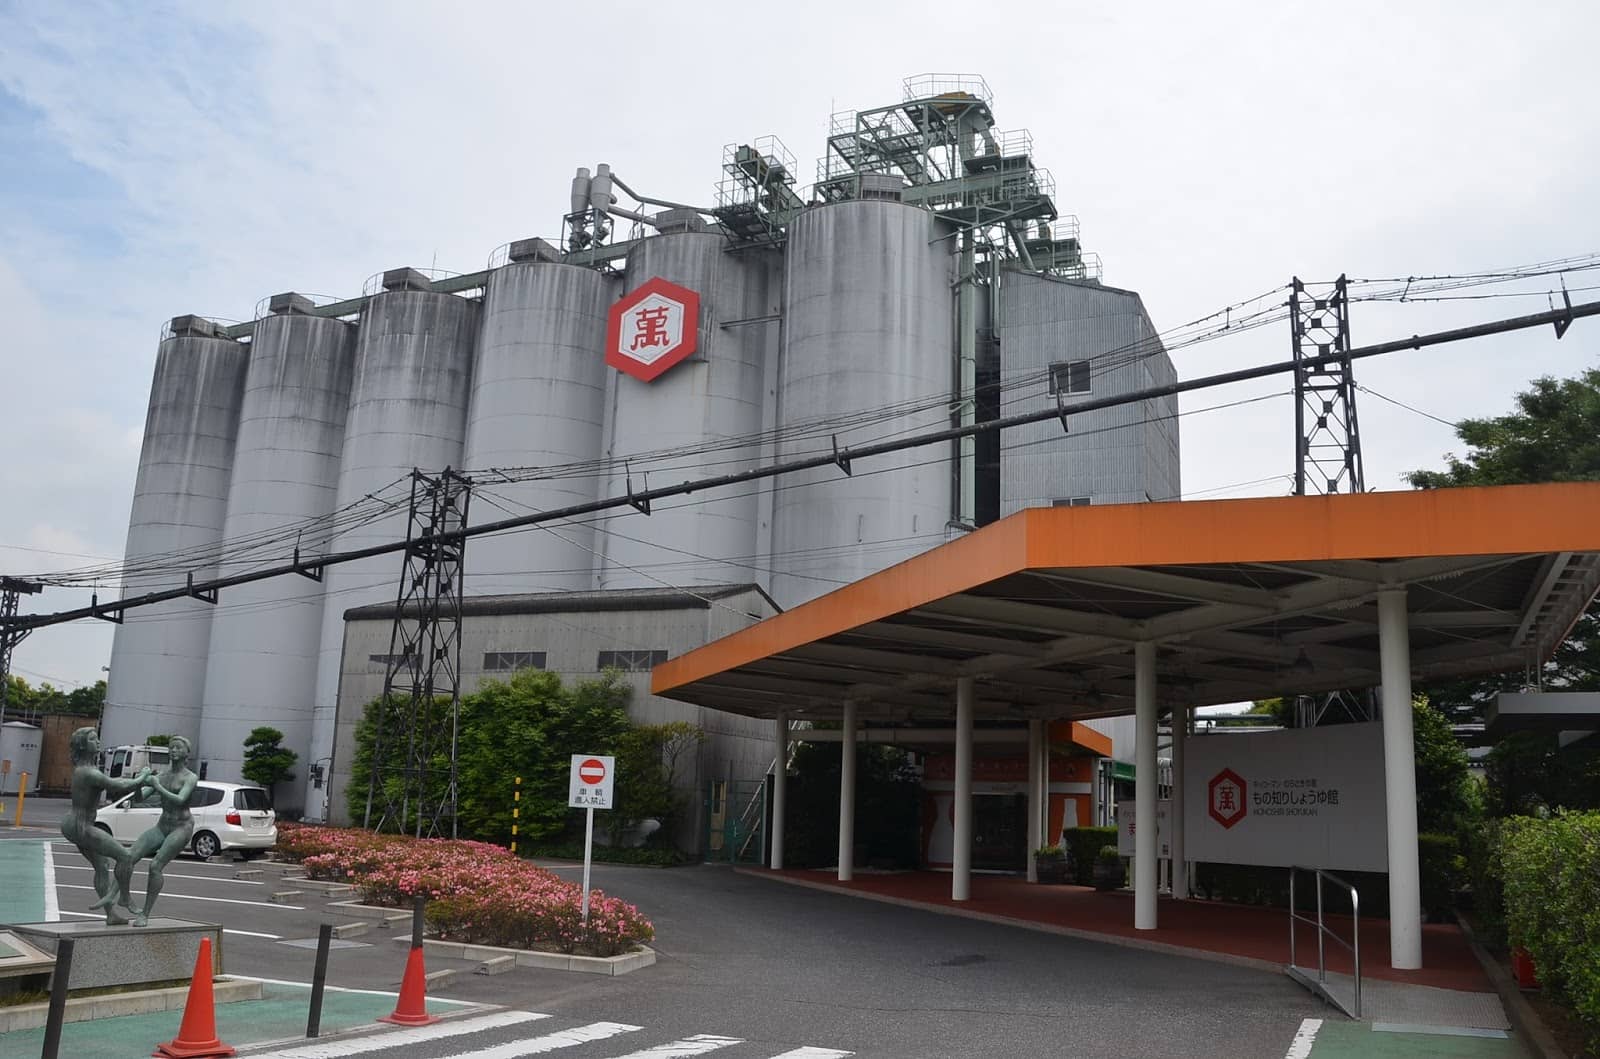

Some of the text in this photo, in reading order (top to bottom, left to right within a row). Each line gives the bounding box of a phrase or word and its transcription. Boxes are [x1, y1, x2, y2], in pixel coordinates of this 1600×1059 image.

[1253, 789, 1339, 805] もの知りしょうゆ館
